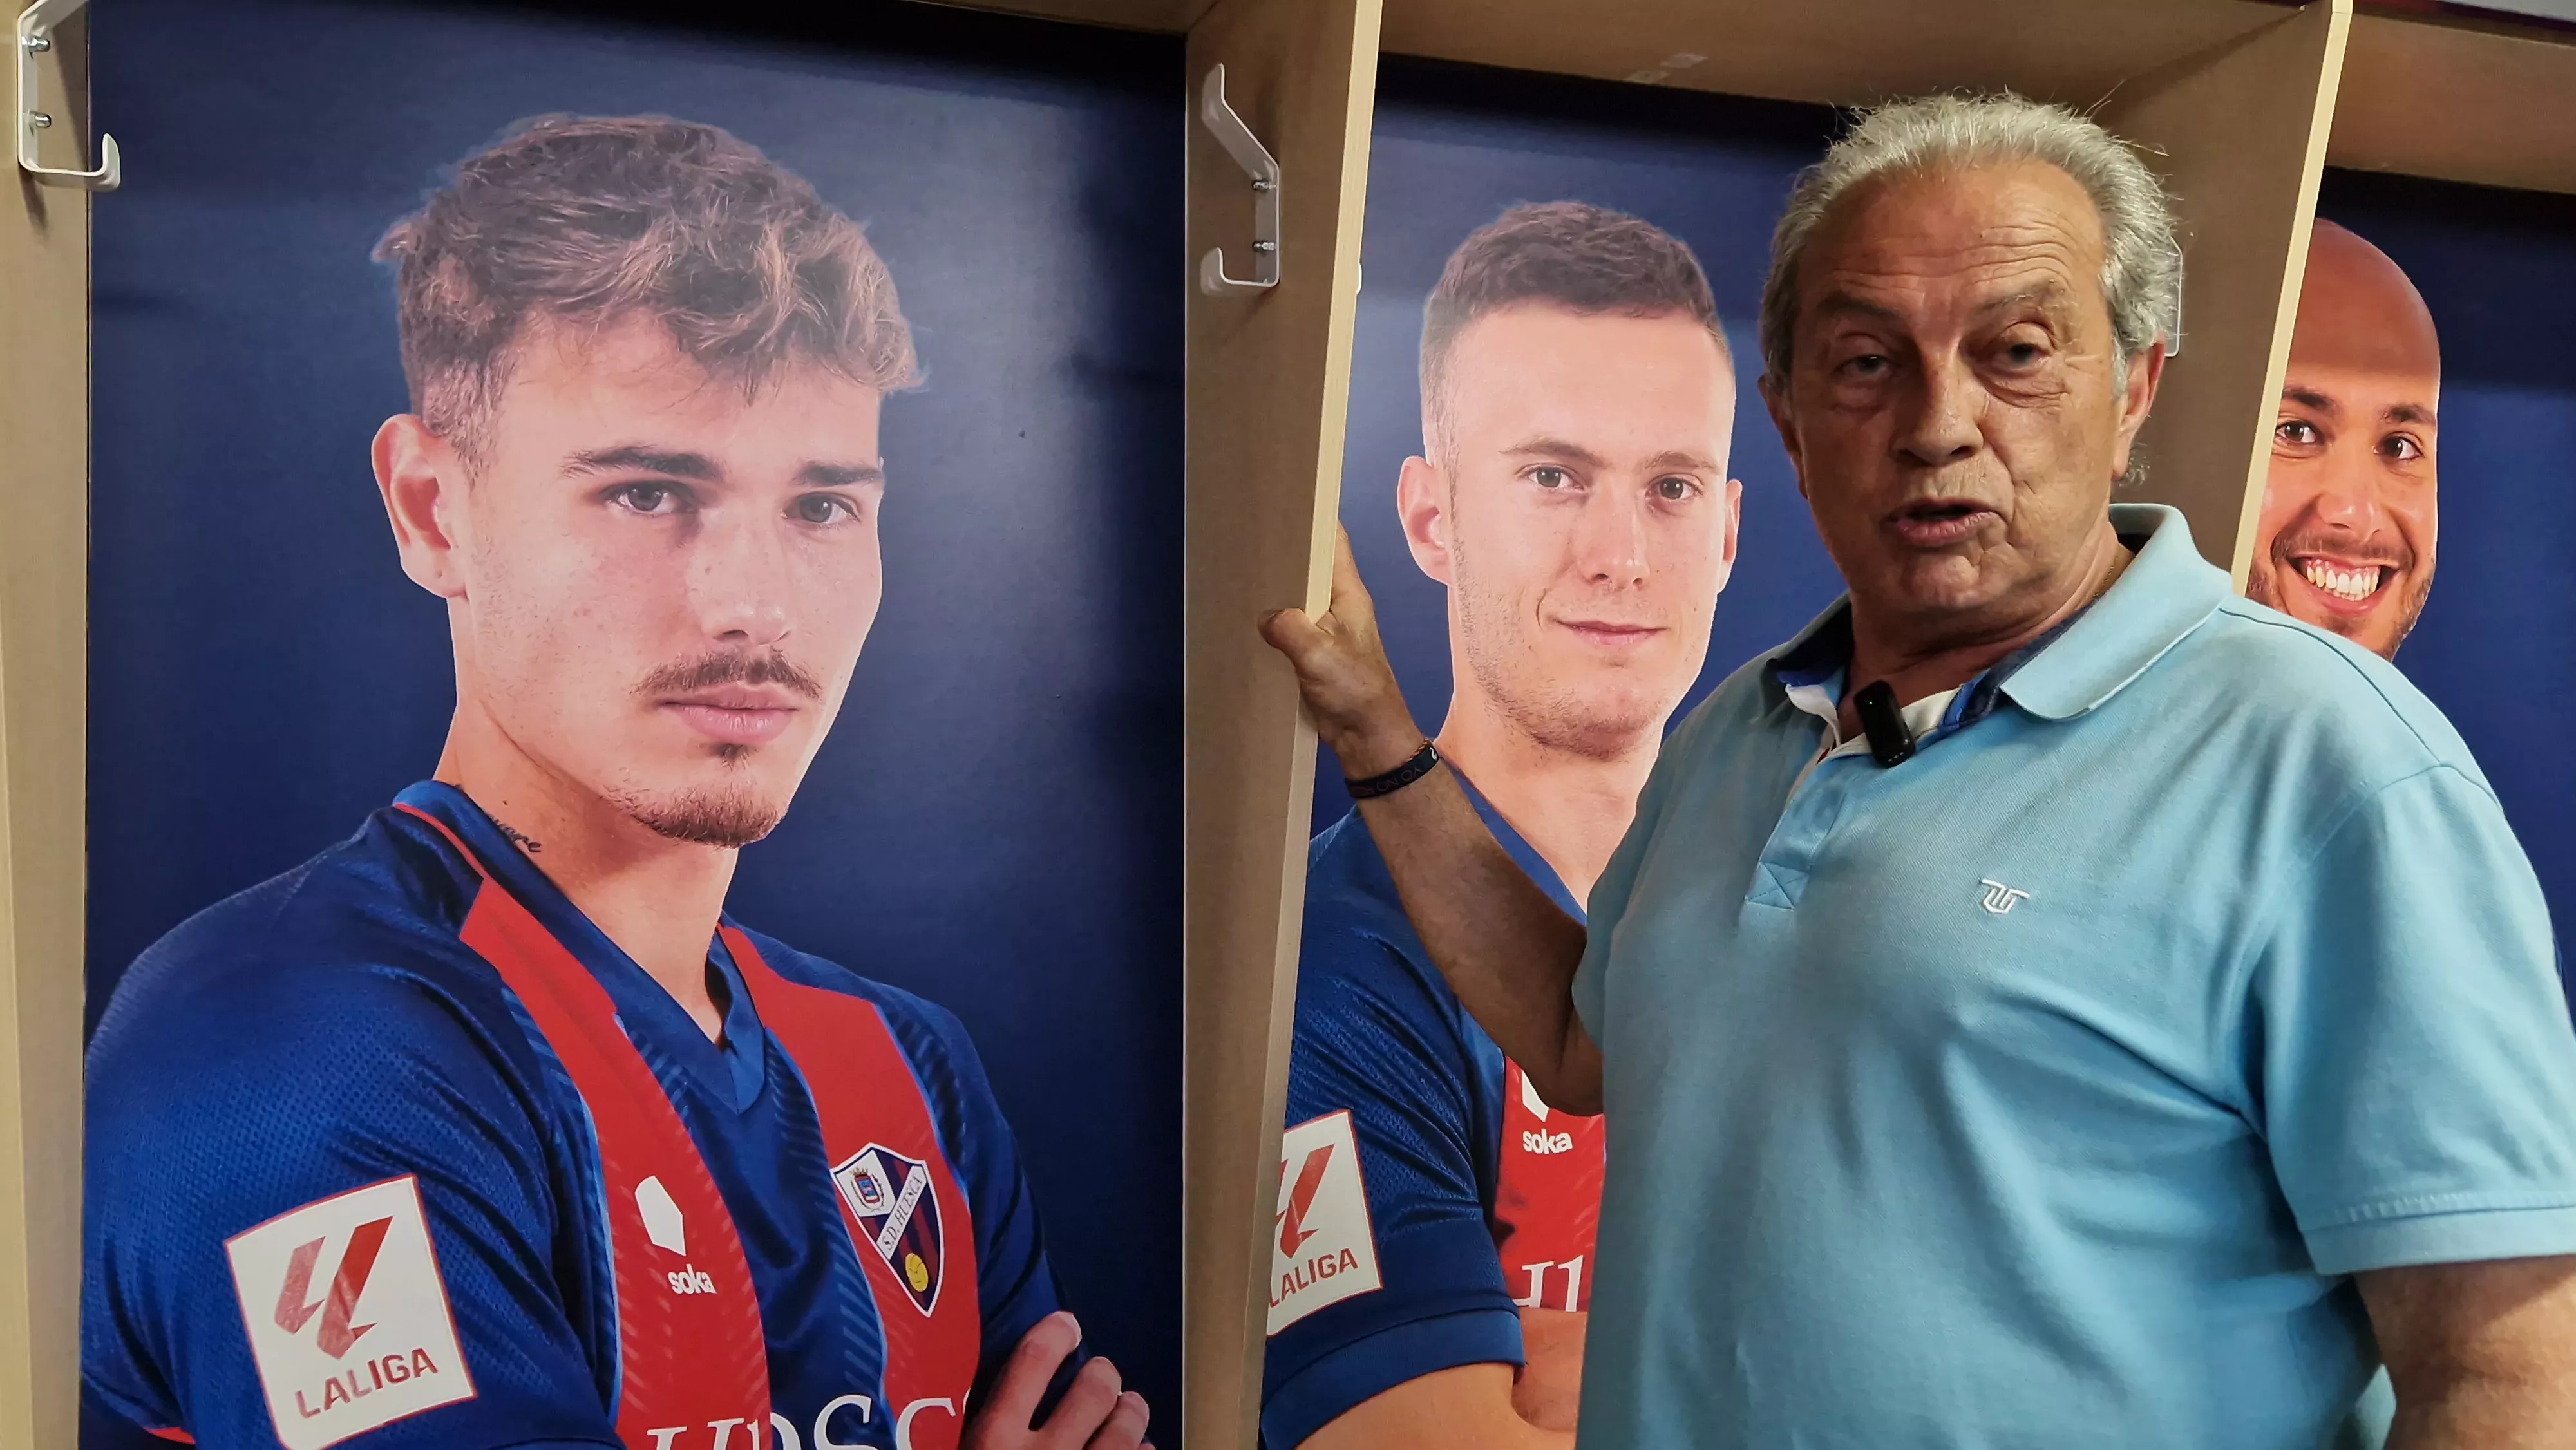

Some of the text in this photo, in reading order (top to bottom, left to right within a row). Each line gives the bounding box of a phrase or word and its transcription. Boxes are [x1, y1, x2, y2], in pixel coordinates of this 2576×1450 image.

[1522, 1128, 1573, 1154] soka
[895, 1176, 923, 1226] HUESCA
[668, 1263, 717, 1295] soka
[1269, 1248, 1358, 1308] LALIGA
[295, 1348, 439, 1419] LALIGA
